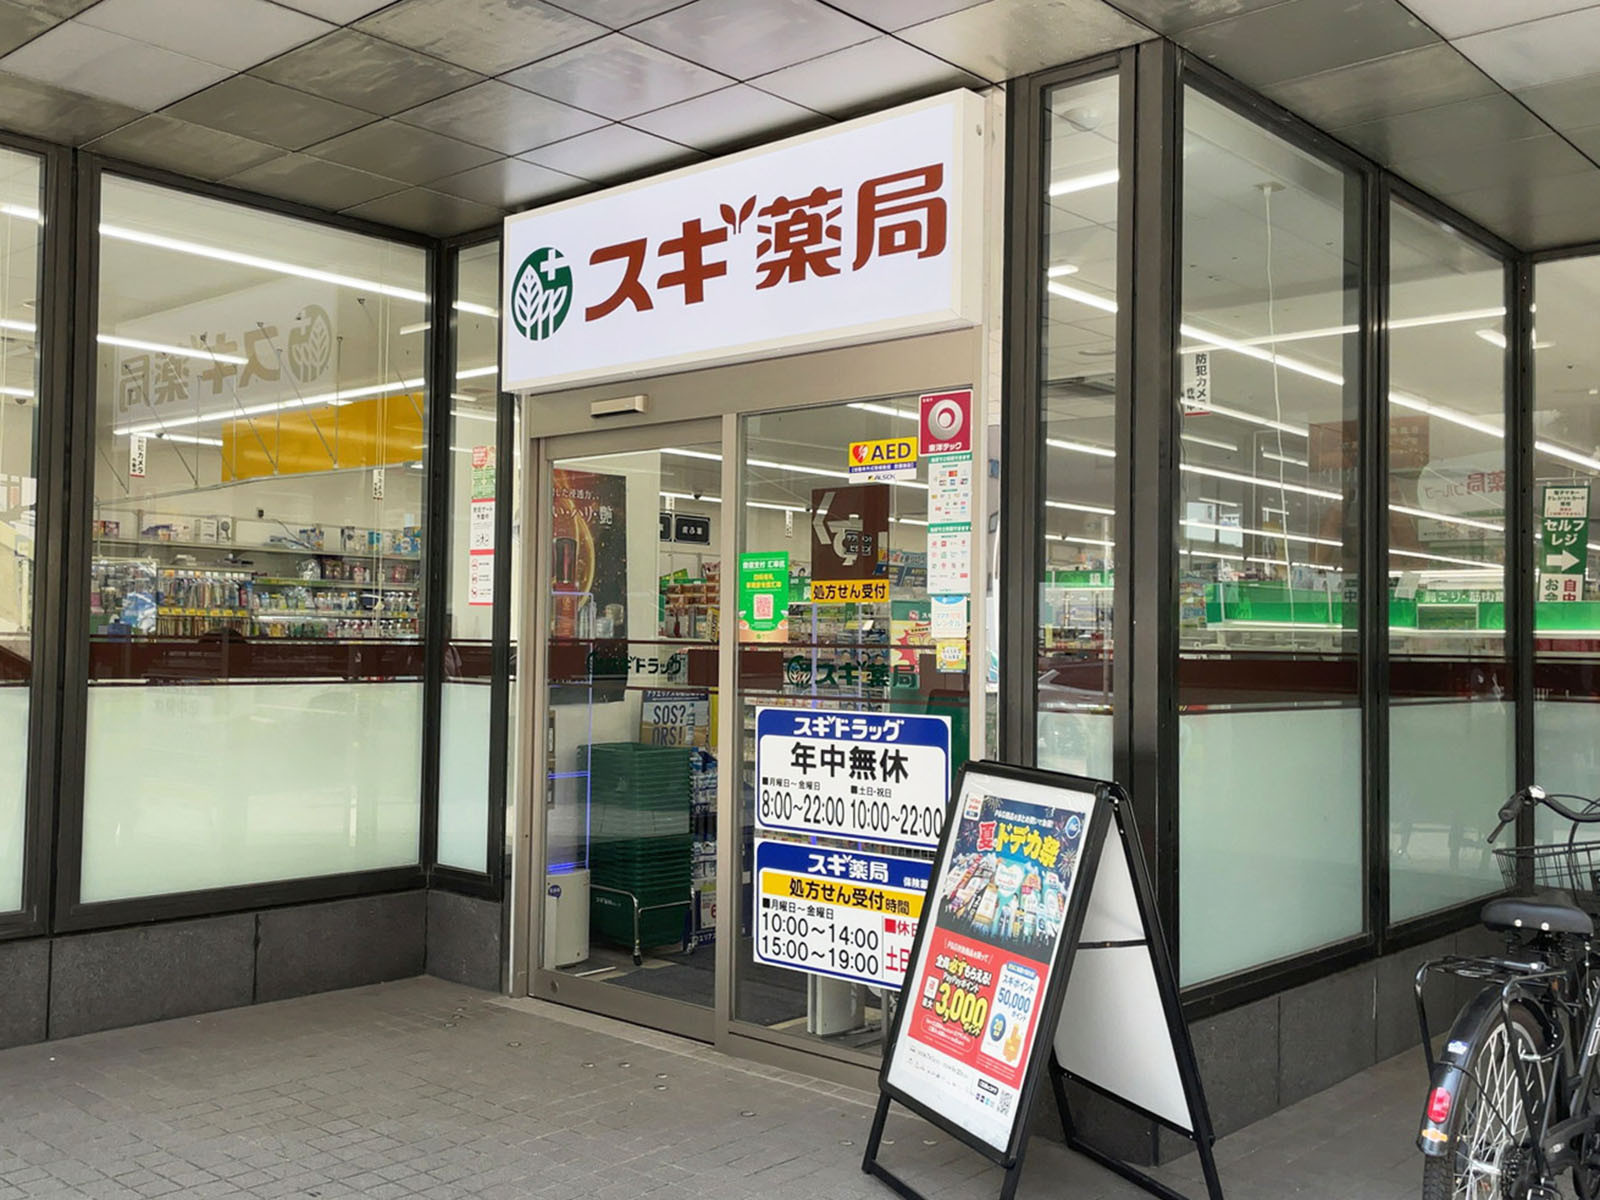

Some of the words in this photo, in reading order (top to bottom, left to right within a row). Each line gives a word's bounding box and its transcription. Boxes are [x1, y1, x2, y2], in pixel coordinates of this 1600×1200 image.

[585, 163, 947, 322] スギ薬局
[871, 442, 911, 461] AED
[1543, 519, 1585, 532] セルフ
[1551, 534, 1577, 546] レジ
[813, 583, 886, 600] 処方せん受付
[816, 660, 918, 688] スギ薬局
[653, 704, 686, 725] SOS?
[793, 716, 905, 740] スギドラッグ
[652, 726, 683, 746] ORS!
[790, 742, 909, 784] 年中無休
[807, 853, 889, 883] スギ薬局
[770, 899, 834, 920] 月曜日～金曜日
[762, 912, 879, 951] 10:00～14:00
[762, 935, 879, 975] 15:00～19:00
[886, 945, 911, 973] 土日
[935, 981, 988, 1028] 3,000
[998, 987, 1031, 1014] 50,000
